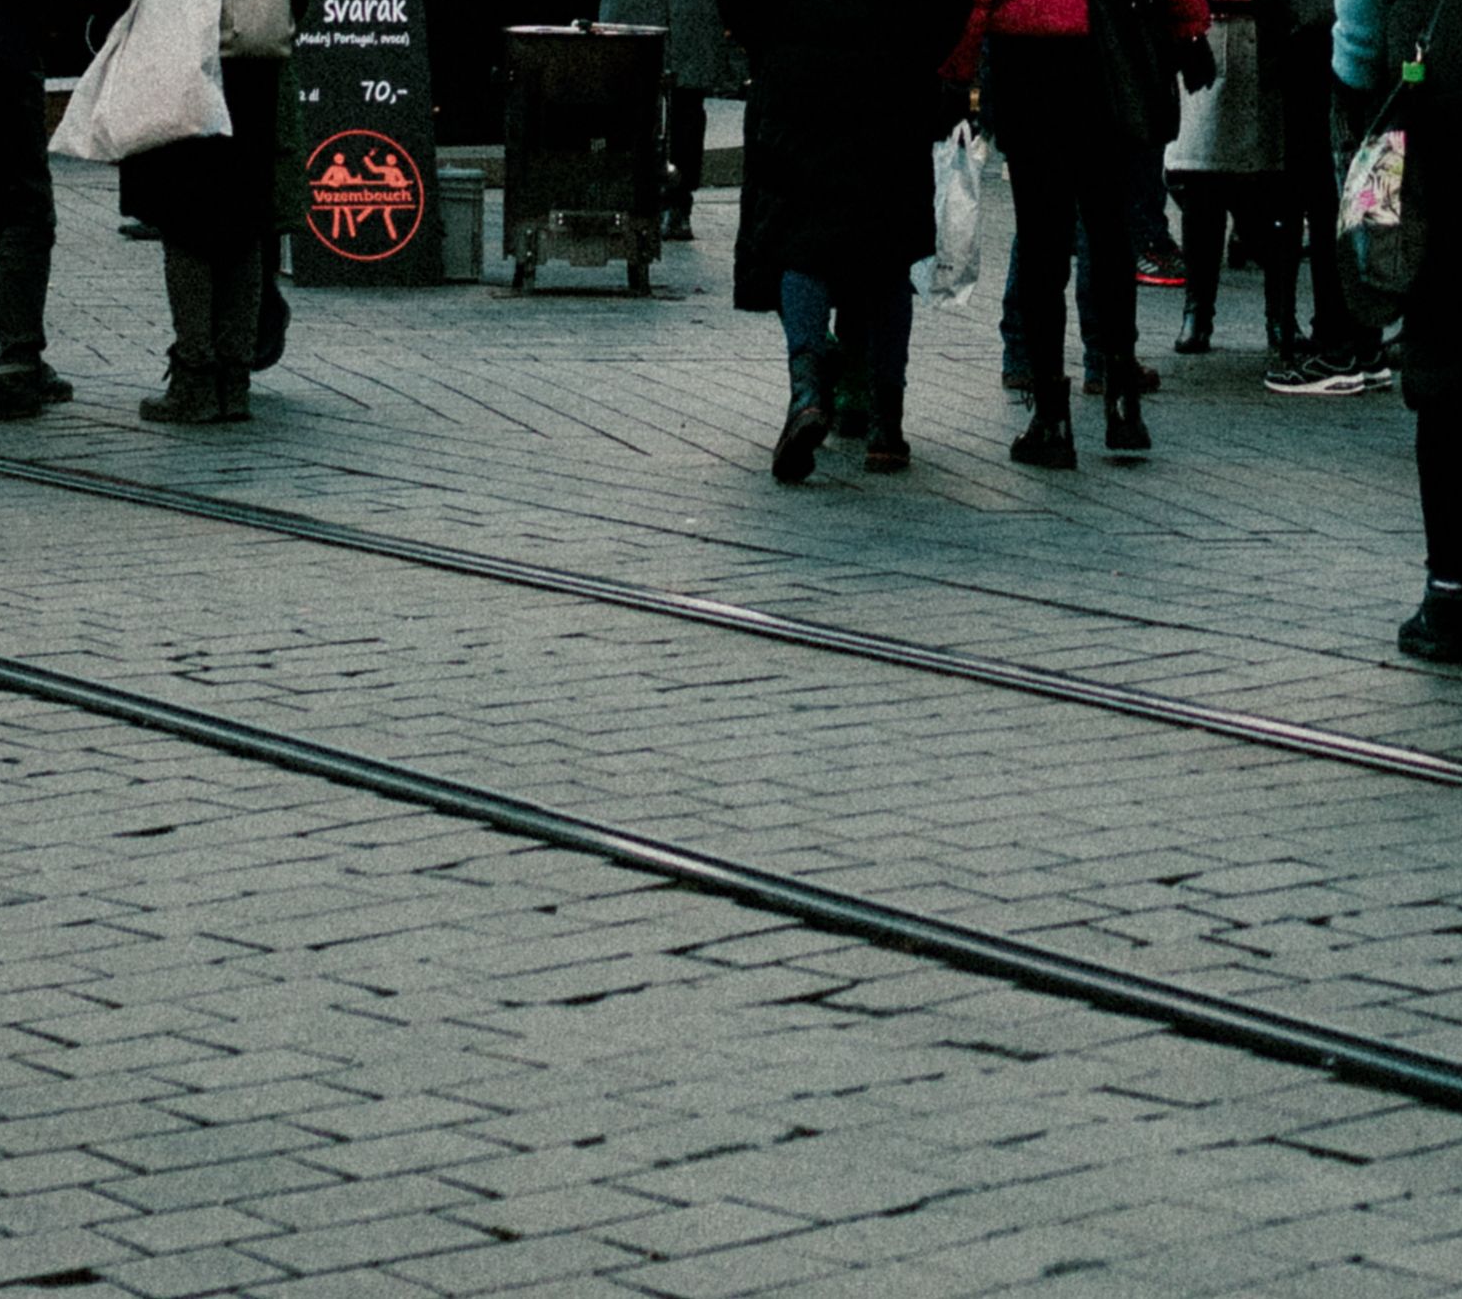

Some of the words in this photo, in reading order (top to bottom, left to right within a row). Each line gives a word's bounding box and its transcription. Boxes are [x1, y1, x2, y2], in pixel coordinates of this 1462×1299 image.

[309, 88, 320, 102] dl
[360, 80, 408, 105] 70,-
[313, 189, 413, 203] Vozembouch
